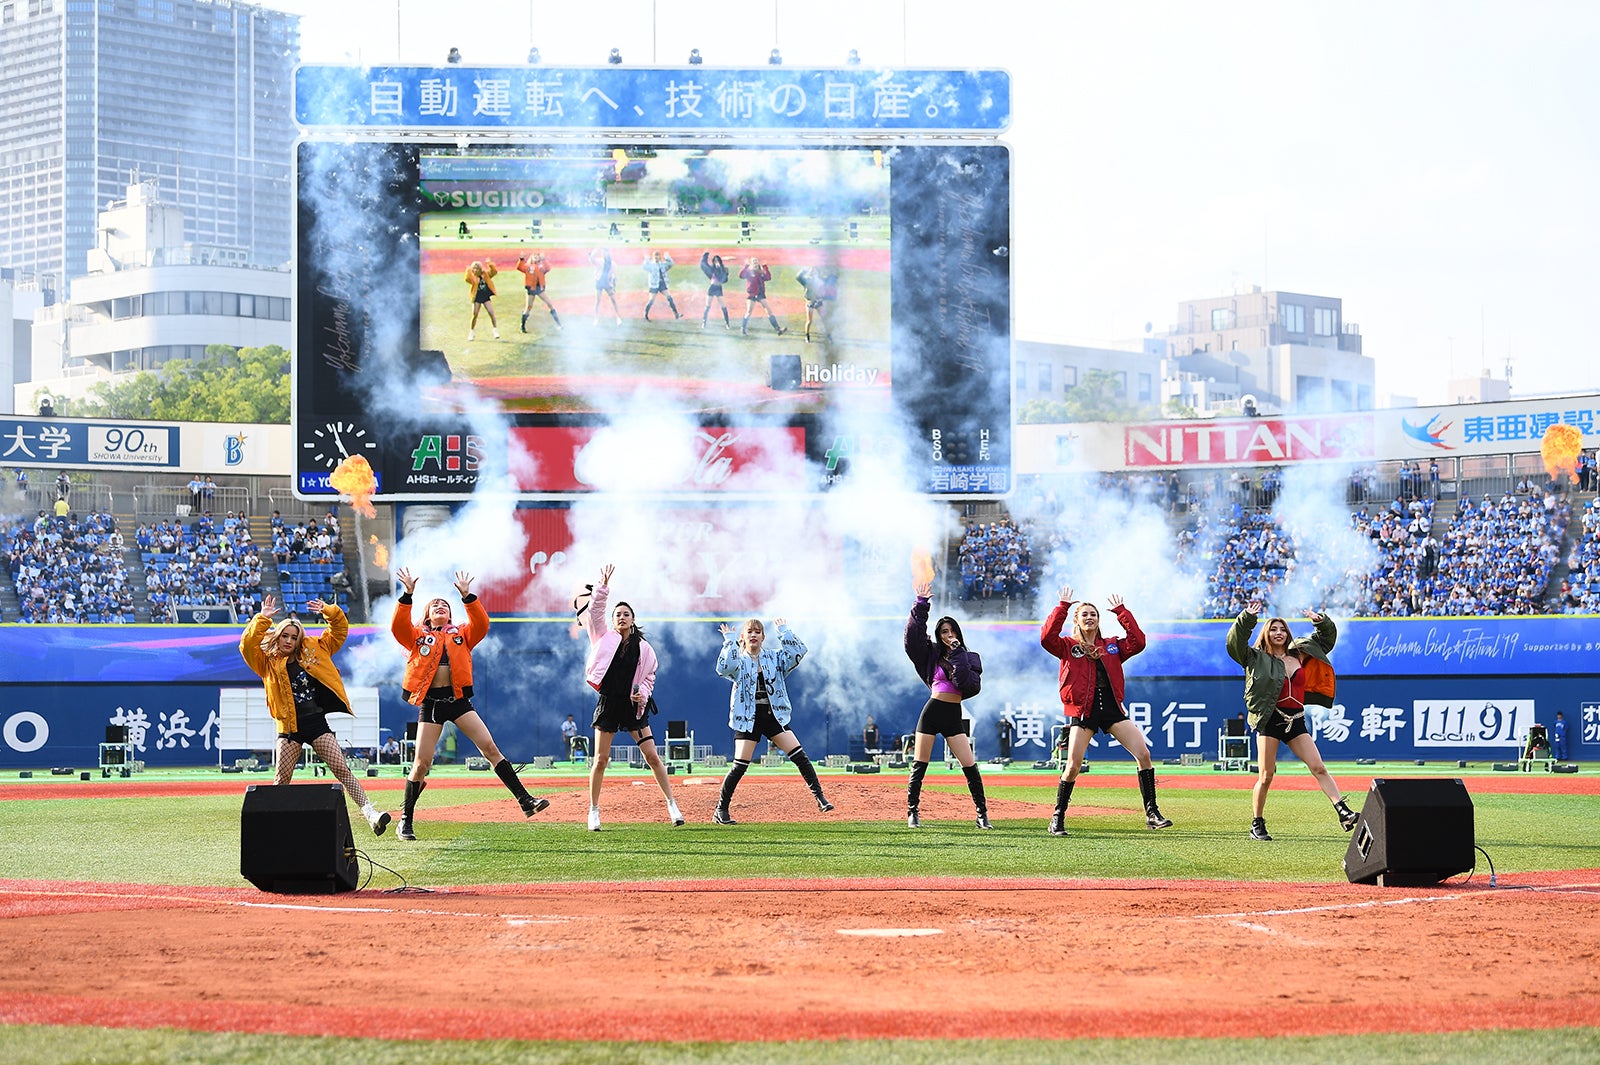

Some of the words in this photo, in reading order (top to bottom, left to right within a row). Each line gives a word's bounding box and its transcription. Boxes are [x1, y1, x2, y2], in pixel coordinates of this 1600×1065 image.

[370, 79, 938, 119] 自動運転へ、技術の日産。
[451, 190, 544, 208] SUGIKO
[805, 363, 878, 386] Holiday
[931, 428, 942, 440] B
[980, 428, 990, 440] H
[1464, 409, 1600, 443] 東亜建設
[3, 425, 72, 459] 大学
[104, 428, 158, 453] 90th
[932, 440, 942, 451] S
[980, 440, 989, 450] E
[1129, 421, 1321, 464] NITTAN
[93, 452, 121, 460] SHOWA
[122, 454, 163, 463] University
[931, 473, 1007, 491] 岩崎学園
[1363, 632, 1423, 667] Yokohama
[1523, 642, 1570, 653] Supported
